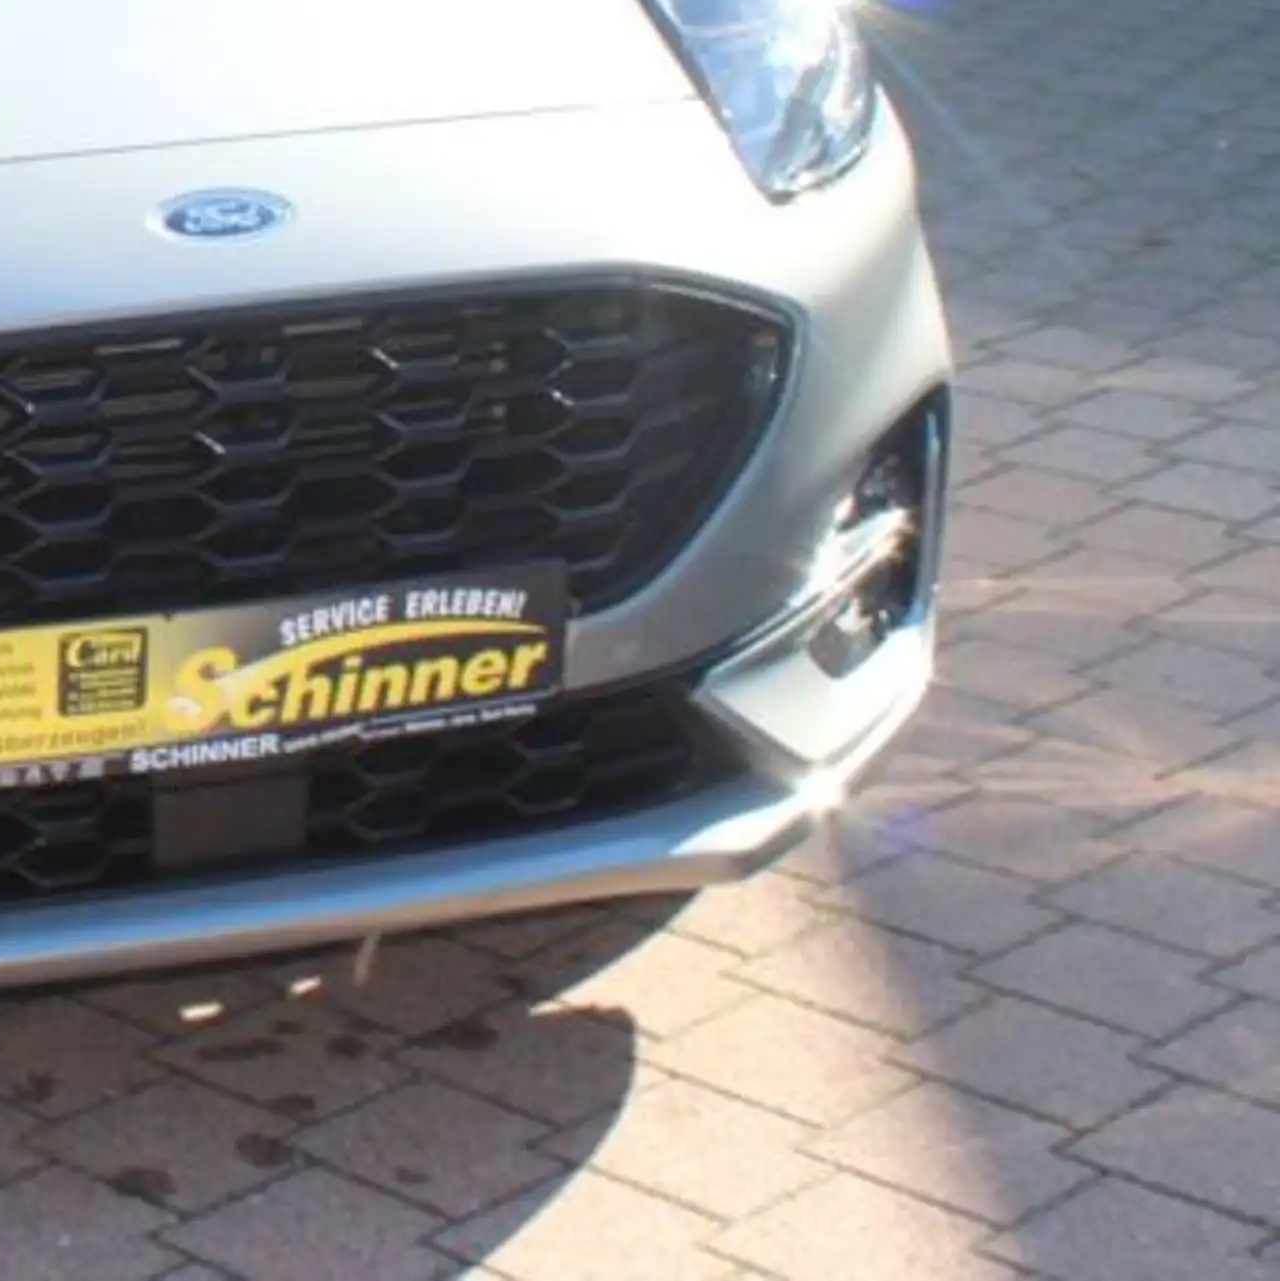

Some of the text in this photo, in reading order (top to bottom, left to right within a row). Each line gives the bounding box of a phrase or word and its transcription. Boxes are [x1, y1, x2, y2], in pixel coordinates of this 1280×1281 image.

[280, 589, 527, 646] SERVICE ERLEBEN!
[165, 640, 548, 735] Schinner
[130, 733, 281, 773] SCHINNER
